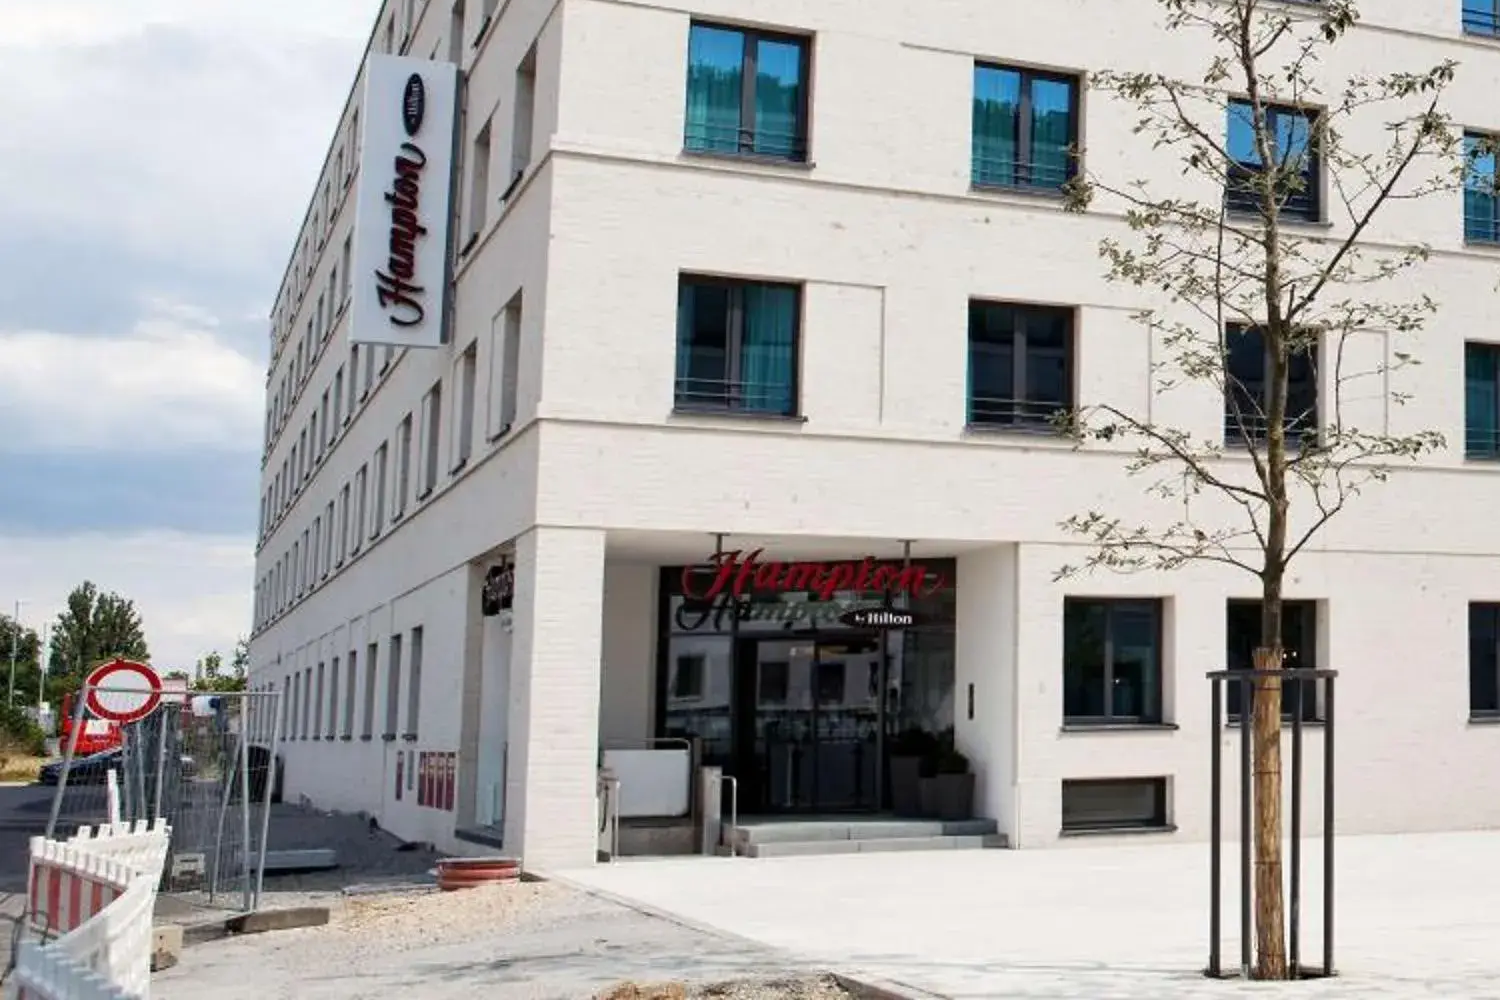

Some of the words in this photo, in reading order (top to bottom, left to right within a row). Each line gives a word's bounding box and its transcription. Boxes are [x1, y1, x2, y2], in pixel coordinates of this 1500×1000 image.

[375, 142, 427, 327] Hampton
[681, 548, 946, 601] Hampton
[867, 611, 913, 625] Hilton
